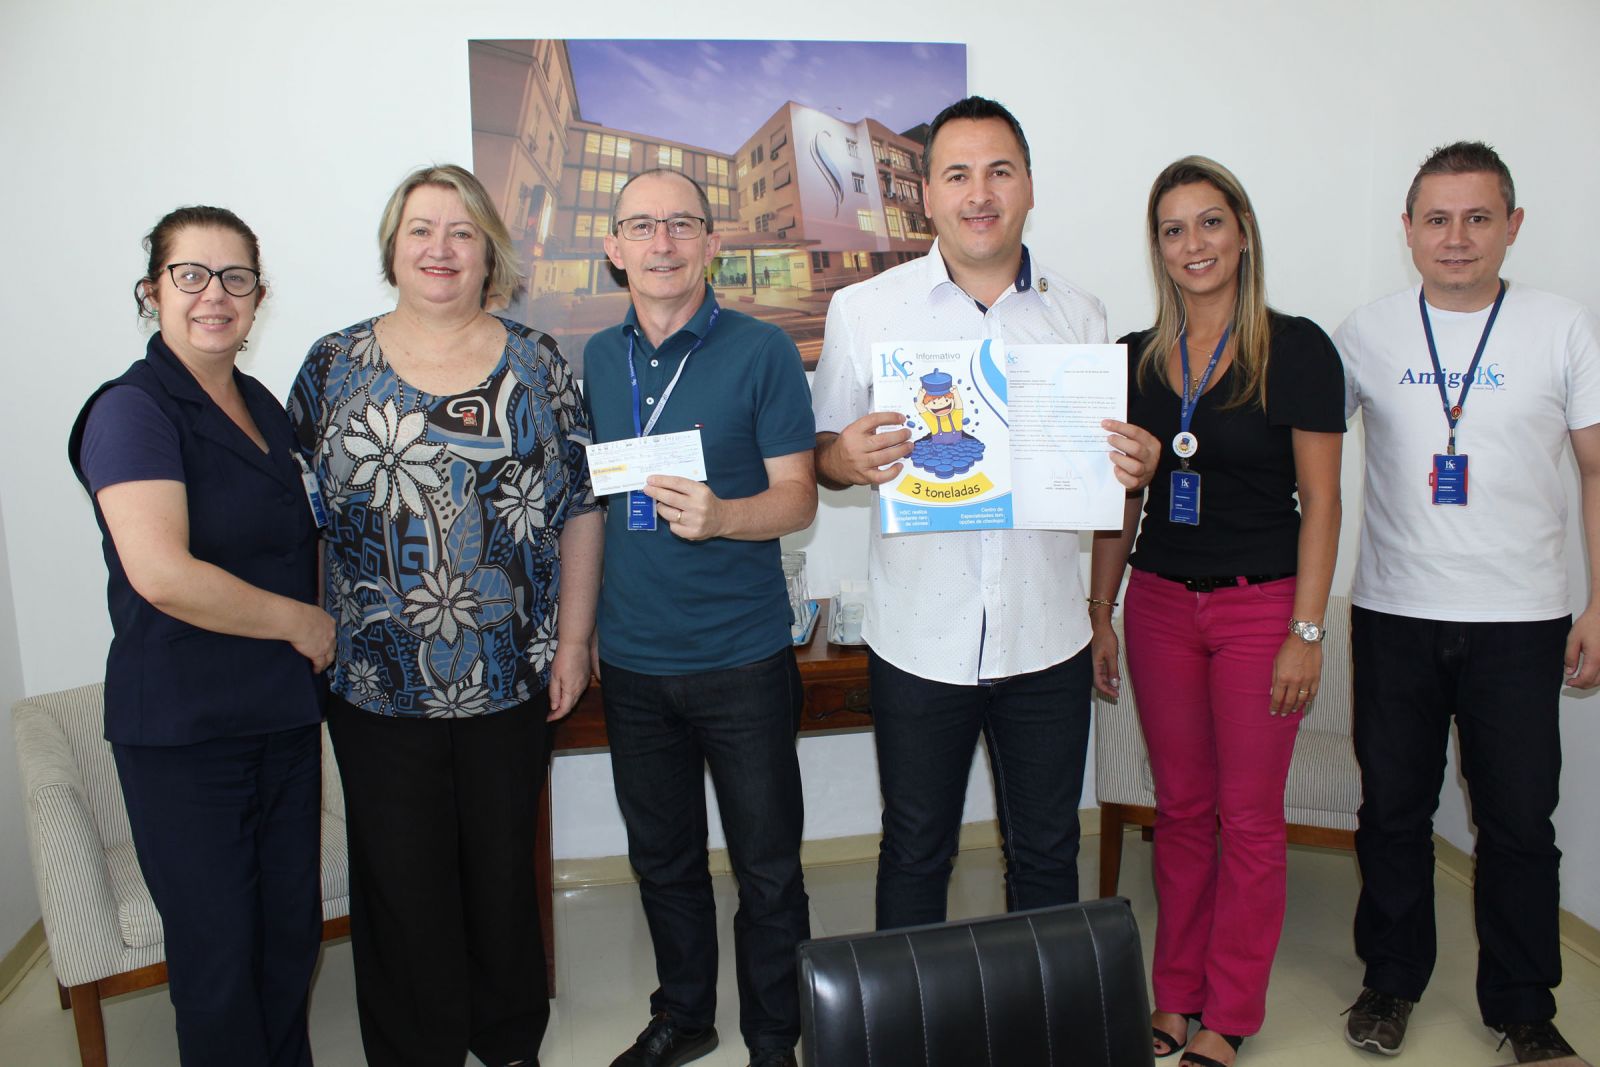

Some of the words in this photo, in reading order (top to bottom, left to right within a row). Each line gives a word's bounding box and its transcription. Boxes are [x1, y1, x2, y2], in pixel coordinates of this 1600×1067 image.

[916, 352, 961, 361] Informativo
[912, 482, 921, 494] 3
[925, 484, 980, 498] toneladas
